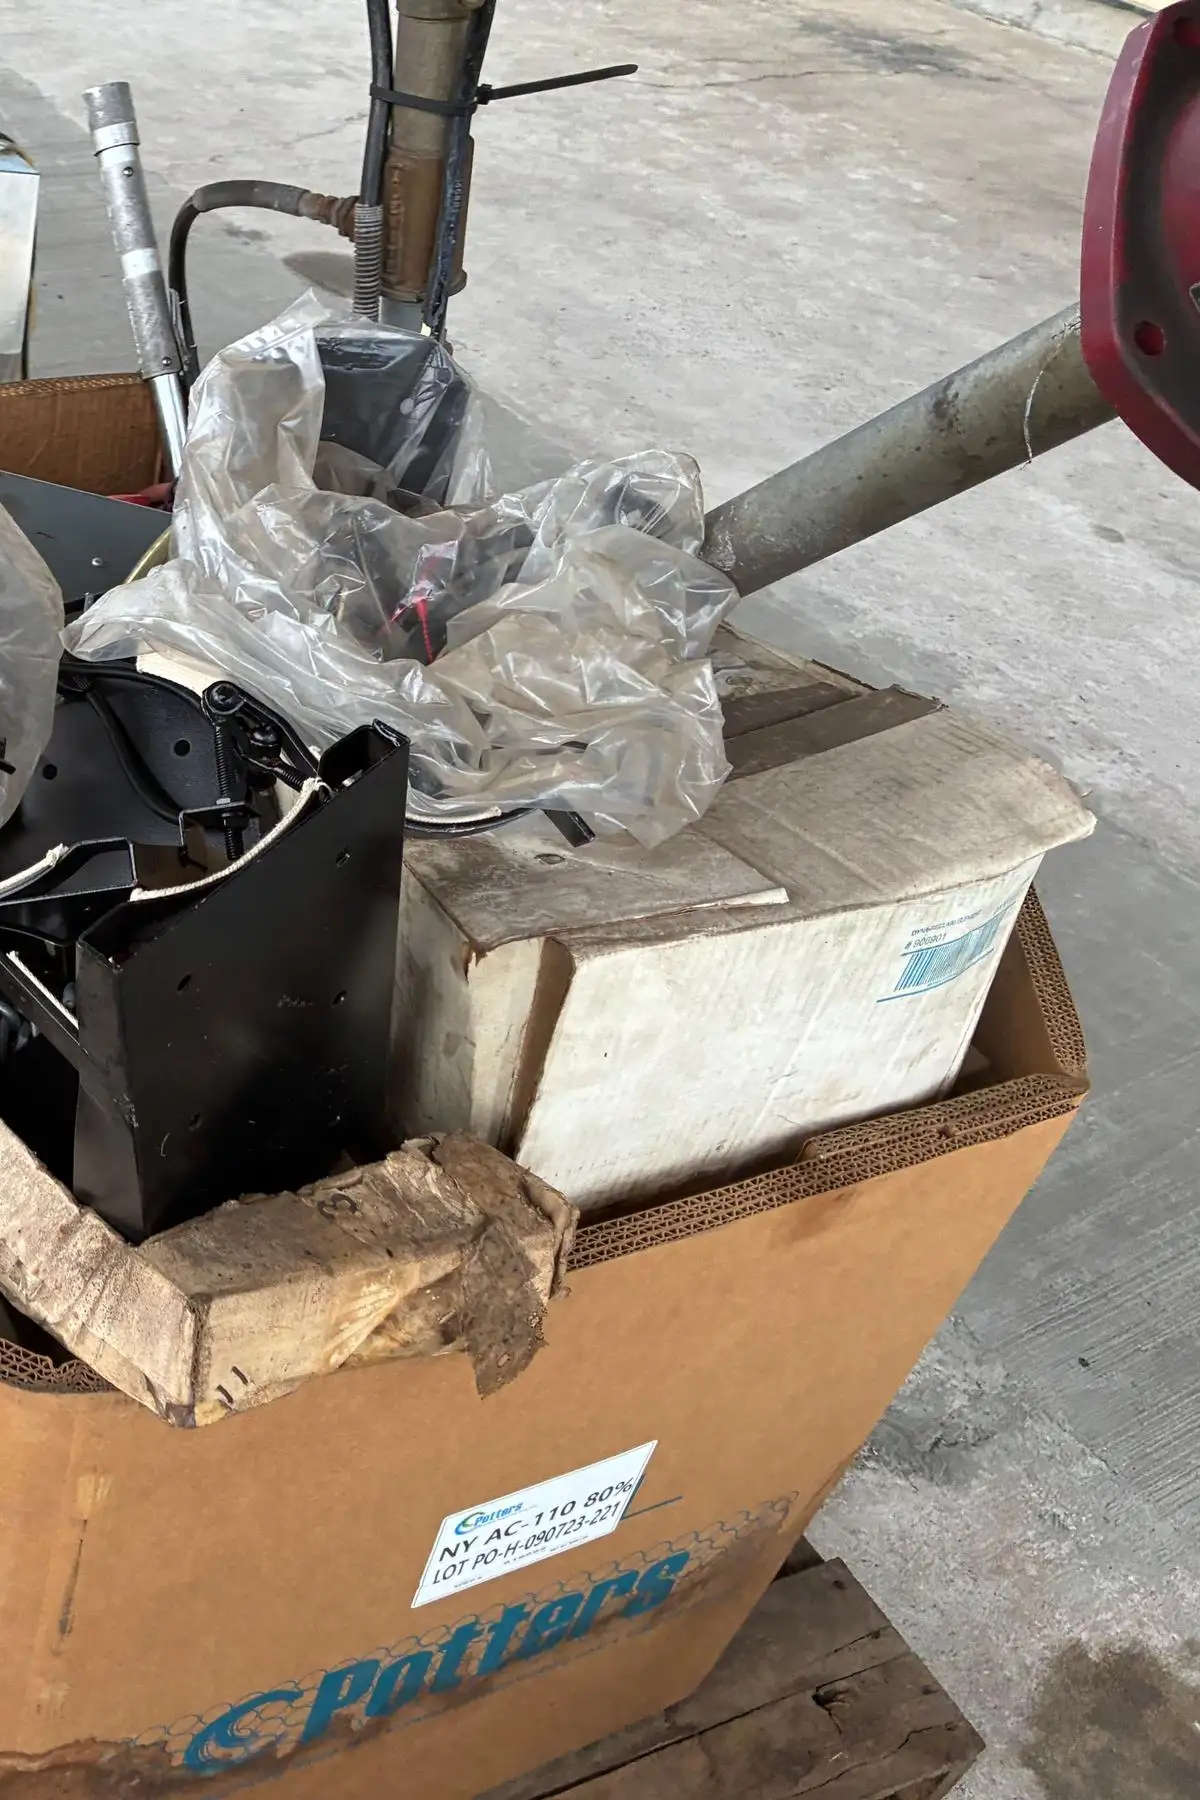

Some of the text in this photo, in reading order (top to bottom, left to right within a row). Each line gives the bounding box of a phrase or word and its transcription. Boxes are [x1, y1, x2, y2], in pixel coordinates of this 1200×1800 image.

[432, 1559, 469, 1585] LOT
[472, 1500, 621, 1571] PO-H-090723-221
[438, 1536, 479, 1562] NY
[583, 1476, 634, 1508] 80%
[474, 1502, 523, 1526] Potters
[300, 1550, 691, 1746] Potters
